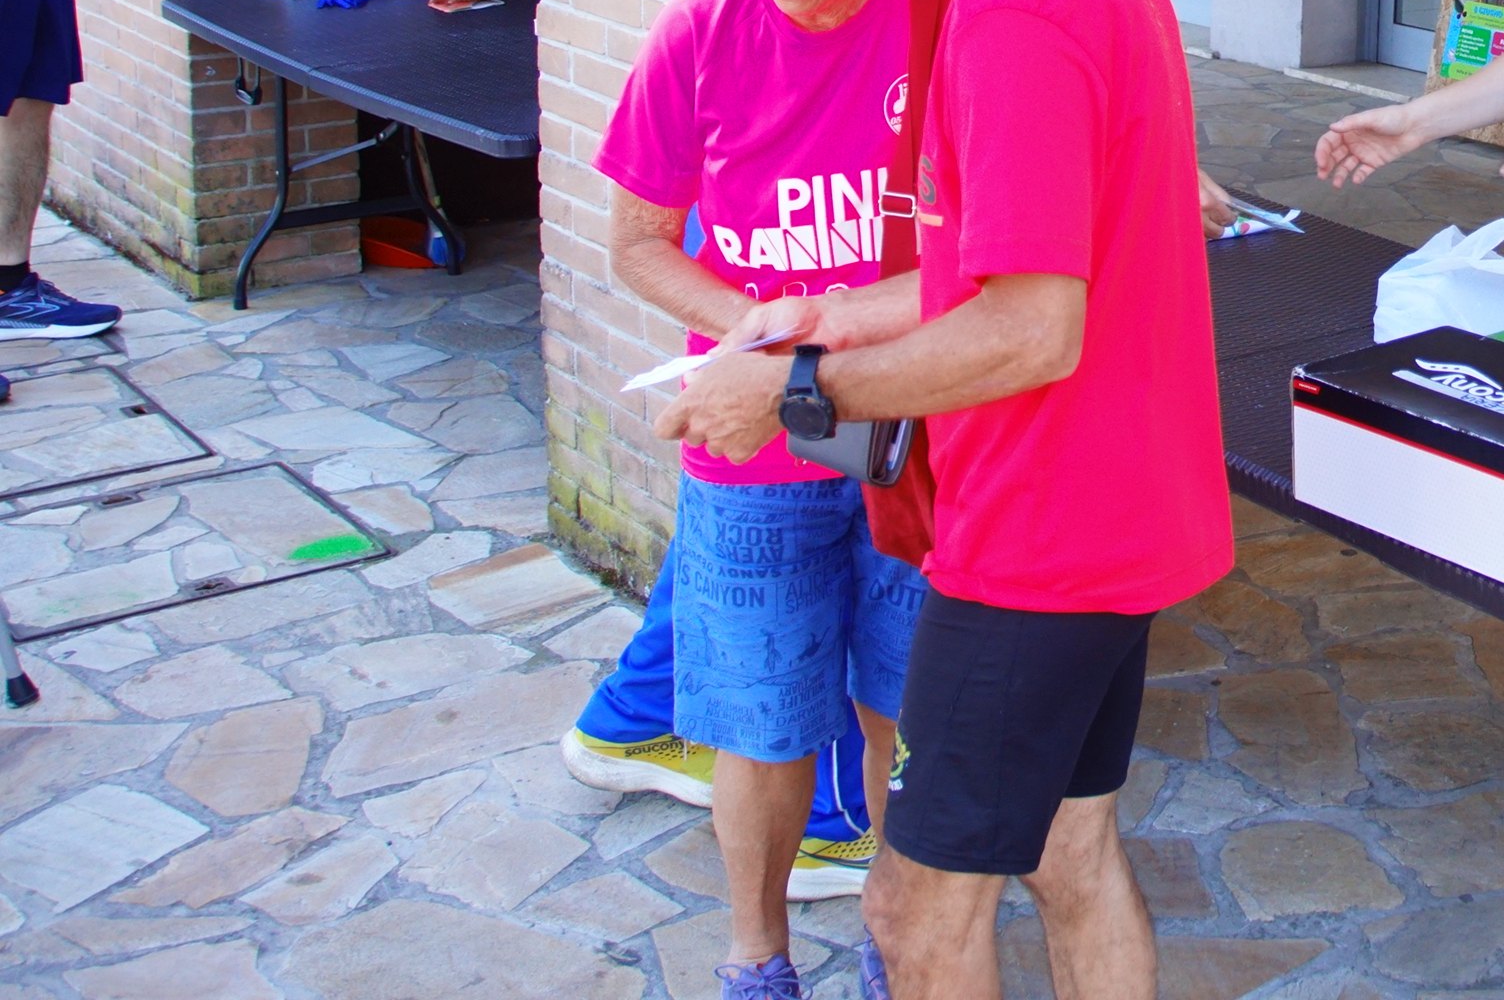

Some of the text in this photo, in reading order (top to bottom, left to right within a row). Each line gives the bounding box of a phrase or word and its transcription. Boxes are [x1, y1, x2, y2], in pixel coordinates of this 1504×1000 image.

[763, 487, 844, 499] DIVING
[715, 521, 784, 547] ROCK
[715, 542, 785, 564] AYERS
[694, 570, 765, 608] CANYON
[776, 696, 828, 727] DARWIN
[624, 740, 685, 757] saucony
